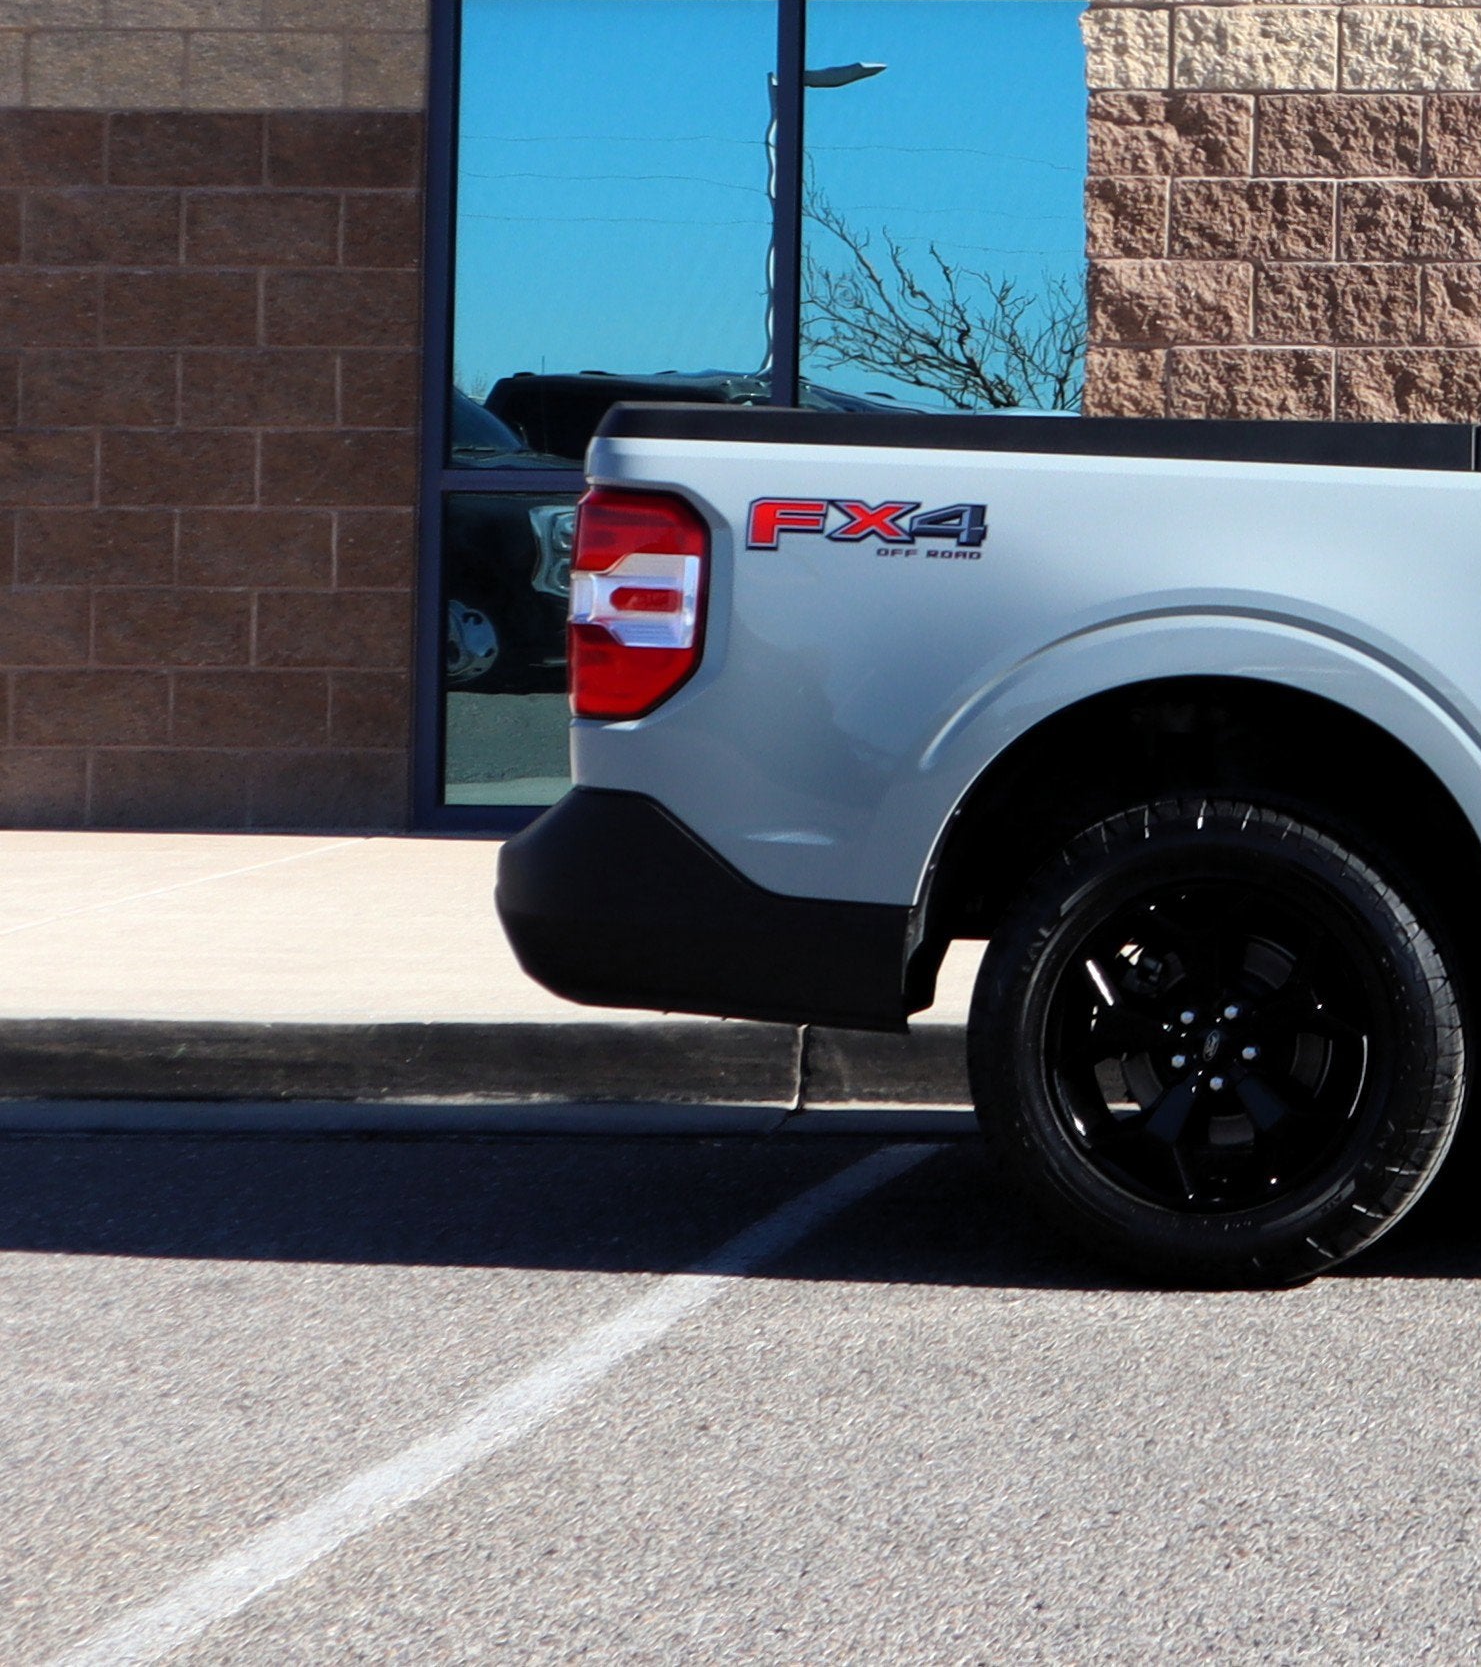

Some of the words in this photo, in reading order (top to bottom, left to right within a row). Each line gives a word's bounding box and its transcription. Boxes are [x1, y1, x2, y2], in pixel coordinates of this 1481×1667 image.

[746, 497, 987, 551] FX4
[876, 547, 919, 558] OFF
[925, 549, 982, 560] ROAD
